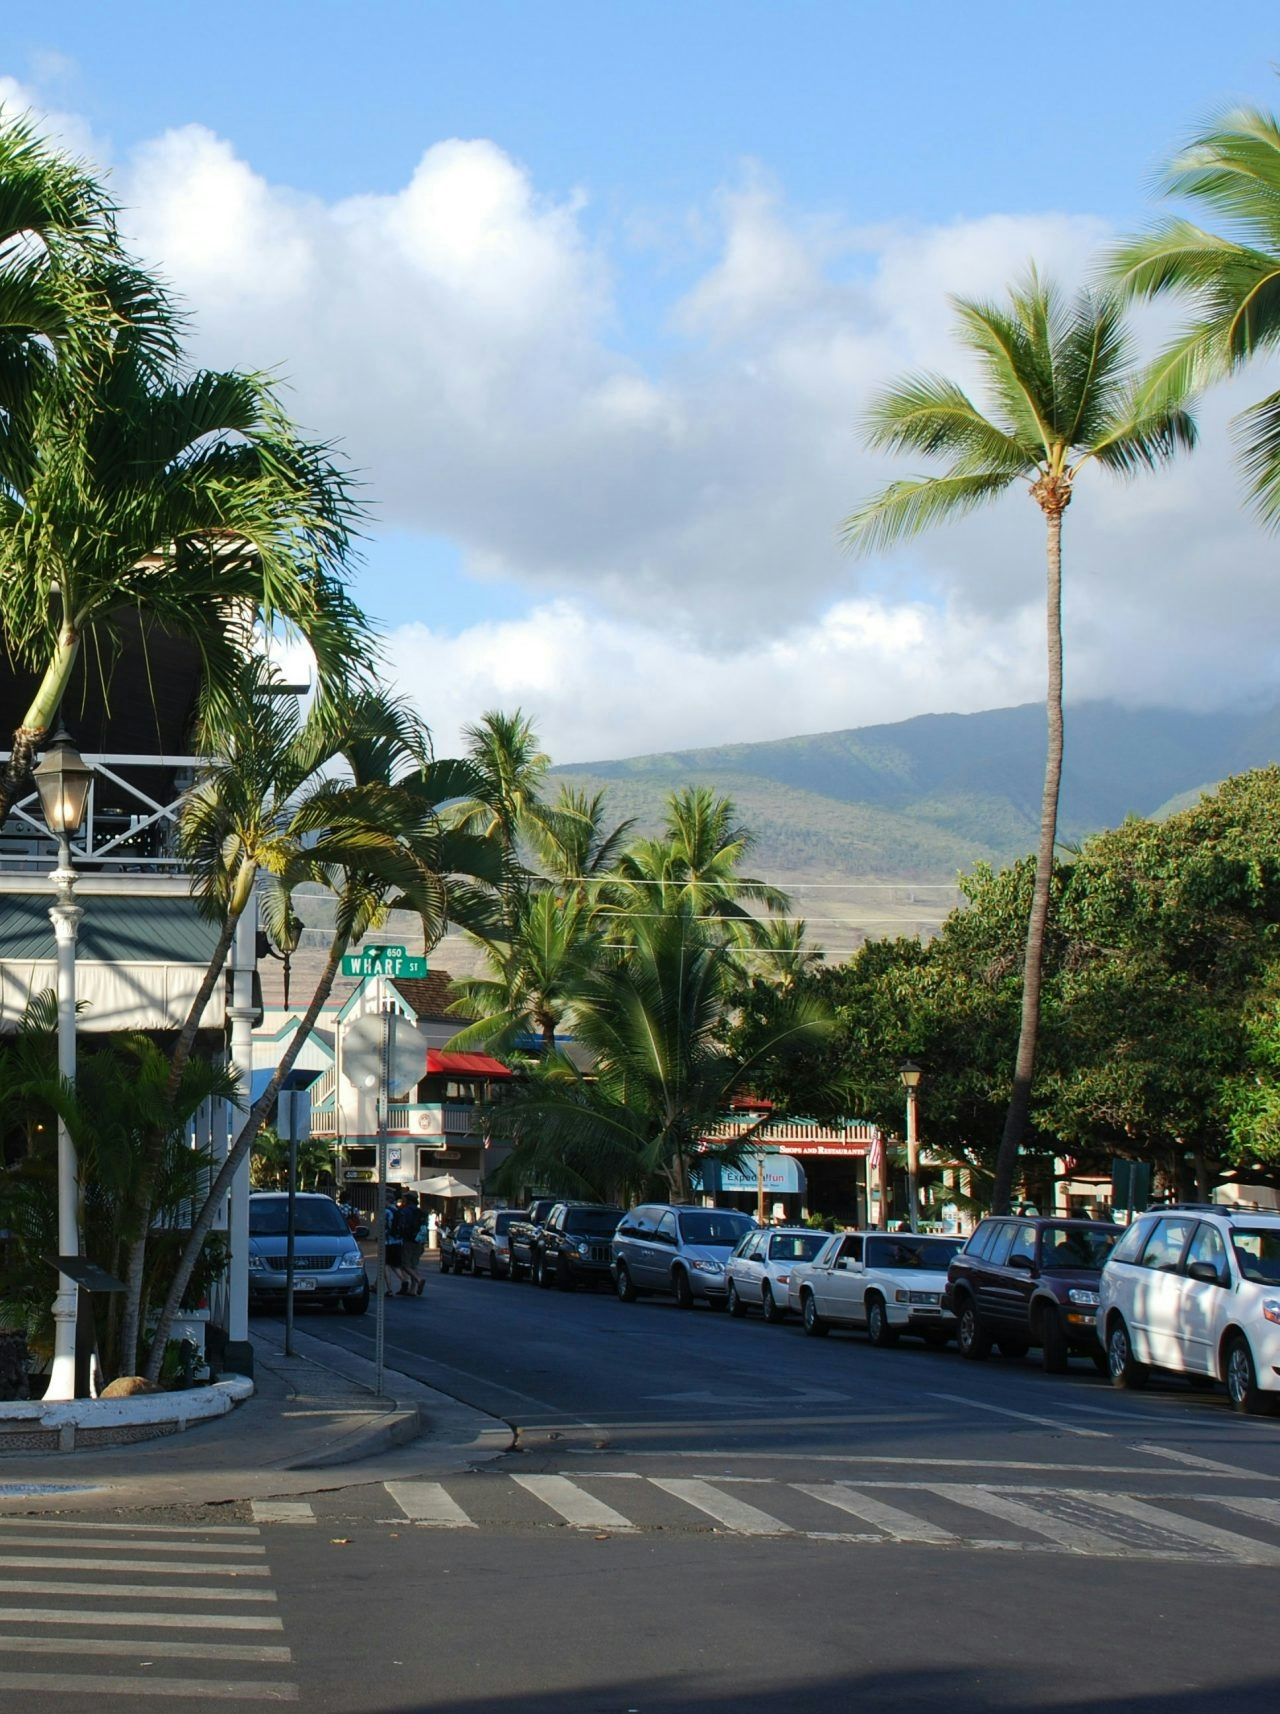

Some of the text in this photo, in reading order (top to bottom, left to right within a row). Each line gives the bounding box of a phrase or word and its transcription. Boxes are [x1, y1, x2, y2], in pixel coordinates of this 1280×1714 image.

[386, 948, 402, 957] 650
[351, 958, 418, 974] WHARF ST
[727, 1173, 784, 1183] Exped!fun
